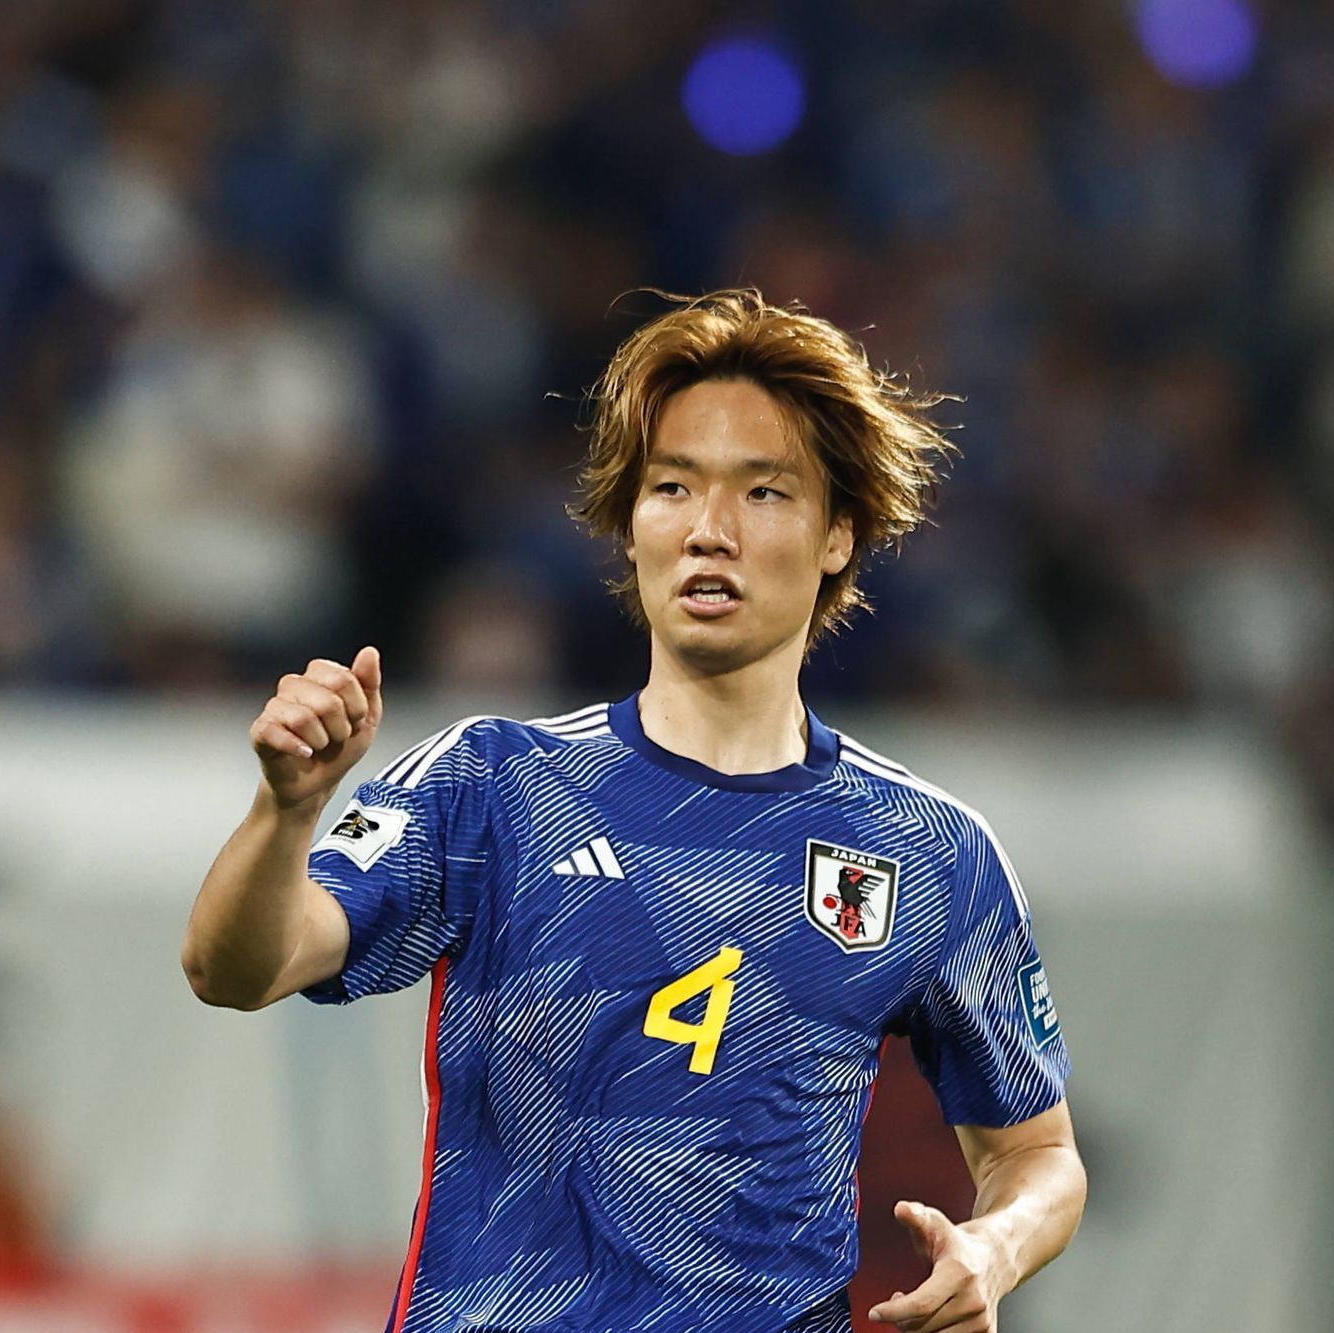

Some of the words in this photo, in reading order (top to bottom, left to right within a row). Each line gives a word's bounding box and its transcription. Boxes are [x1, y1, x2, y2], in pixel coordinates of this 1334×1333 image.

[830, 849, 877, 868] JAPAN
[830, 913, 867, 938] JFA
[643, 946, 744, 1075] 4
